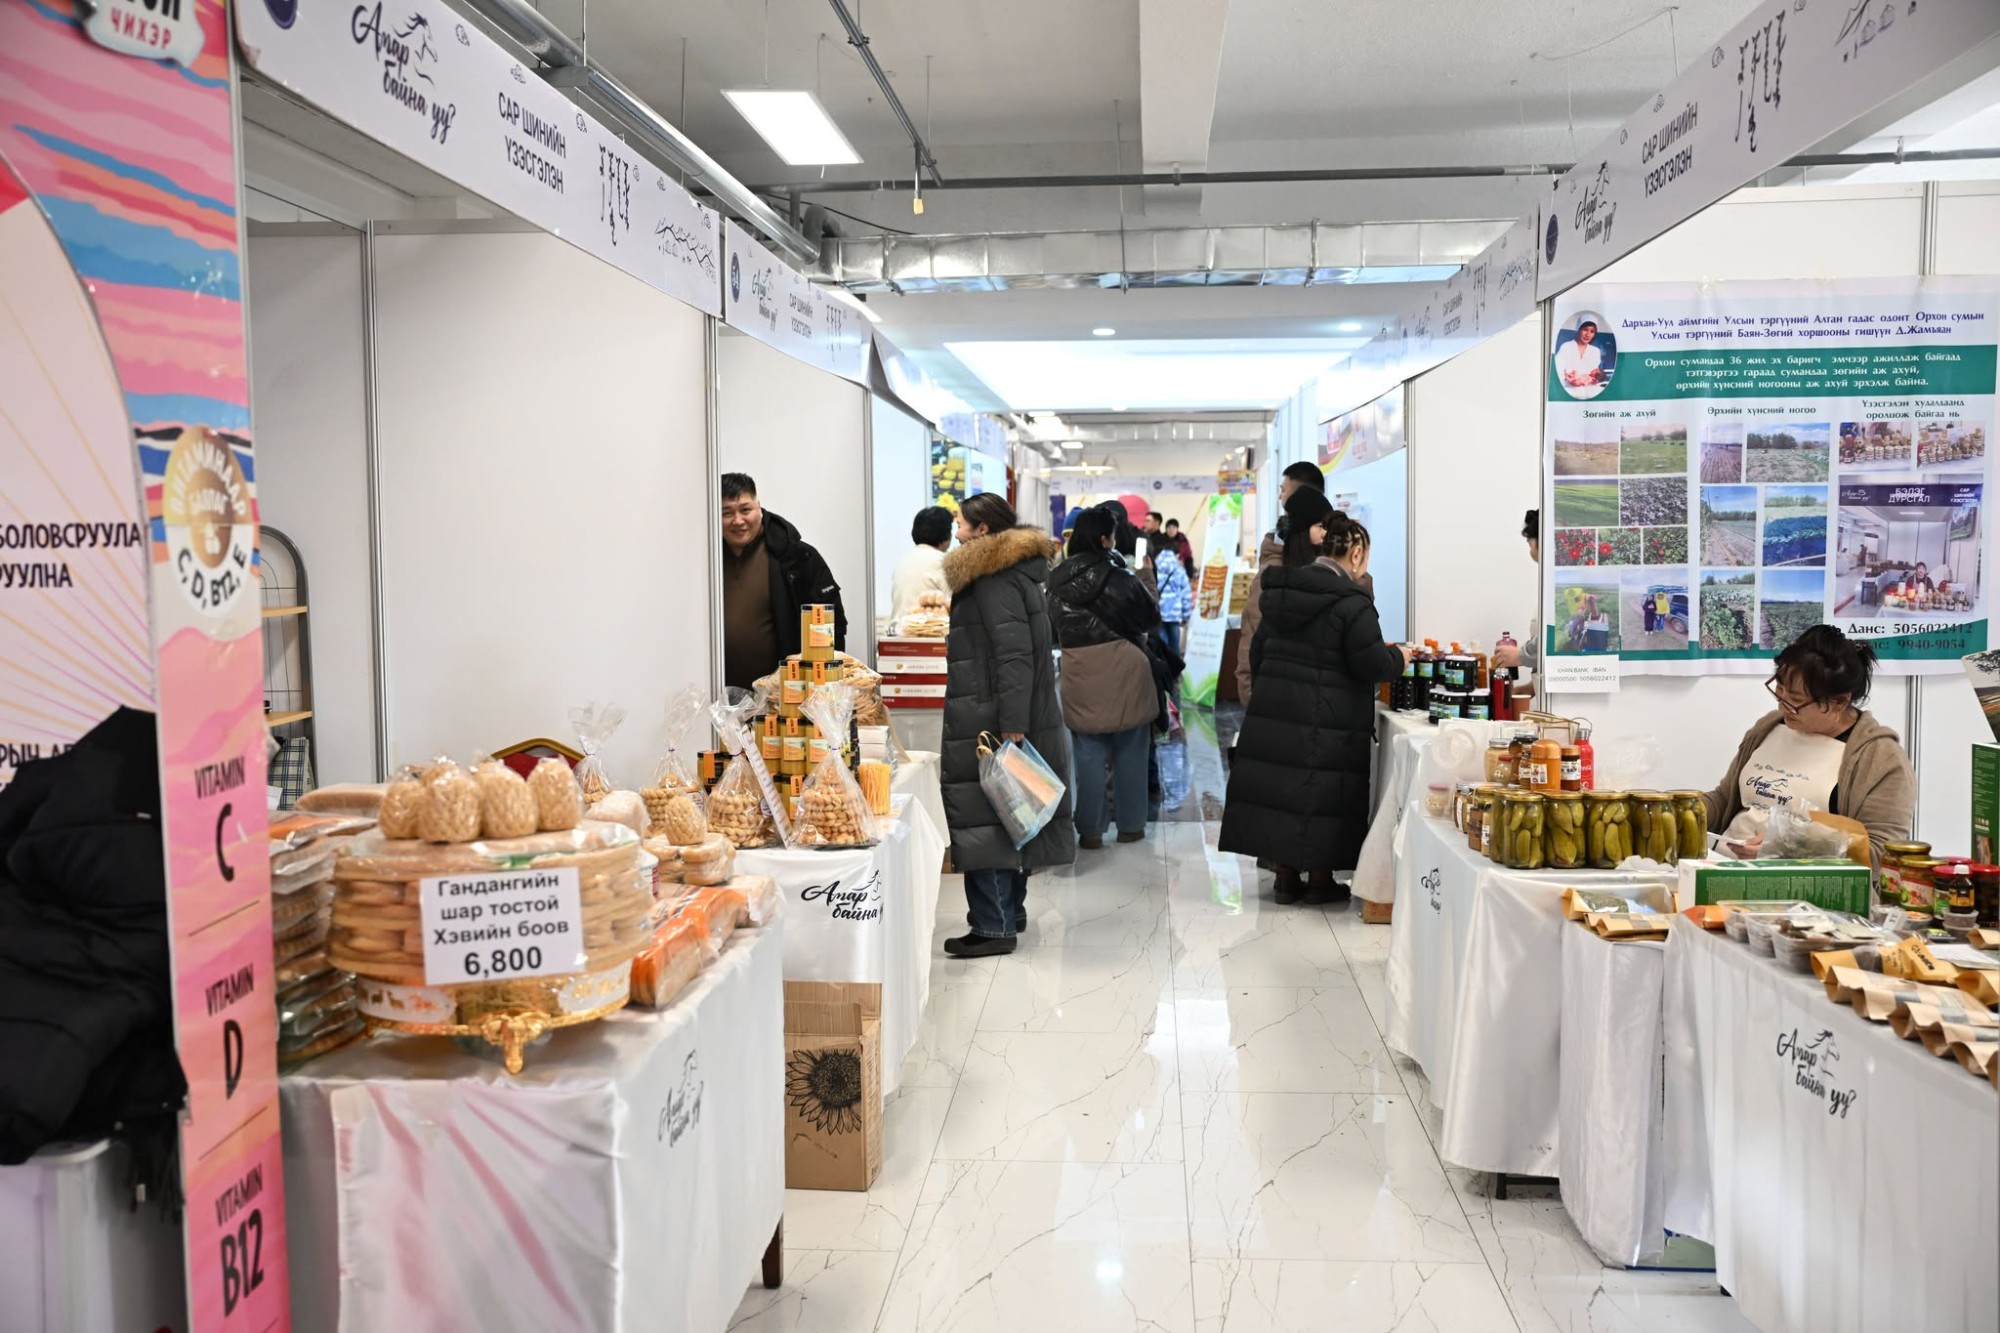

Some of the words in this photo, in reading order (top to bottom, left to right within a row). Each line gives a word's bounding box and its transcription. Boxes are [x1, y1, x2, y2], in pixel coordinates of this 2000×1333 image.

[110, 7, 172, 49] ЧИХЭР
[382, 59, 428, 116] байна
[430, 102, 457, 145] уу?
[498, 91, 520, 126] САР
[521, 106, 567, 159] ШИНИЙН
[1641, 132, 1658, 165] САР
[1658, 101, 1698, 153] ШИНИЙН
[504, 134, 564, 195] ҮЗЭСГЭЛЭН
[1644, 143, 1693, 199] ҮЗЭСГЭЛЭН
[1622, 317, 1674, 330] Дархан-Уул
[1678, 316, 1719, 327] аймгийн
[1724, 315, 1755, 326] Улсын
[1759, 314, 1809, 327] тэргүүний
[1813, 314, 1843, 324] Алтан
[1847, 314, 1876, 324] гадас
[1880, 314, 1910, 323] одонт
[1915, 311, 1947, 324] Орхон
[1951, 312, 1985, 324] сумын
[1651, 330, 1680, 341] Улсын
[1685, 328, 1733, 342] тэргүүний
[1737, 327, 1794, 339] Баян-Зөгий
[1797, 328, 1851, 340] хоршооны
[1854, 327, 1891, 339] гишүүн
[1644, 358, 1676, 370] Орхон
[1680, 357, 1725, 368] сумандаа
[1729, 356, 1742, 366] 36
[1747, 356, 1767, 365] жил
[1770, 356, 1782, 365] эх
[1786, 354, 1821, 366] баригч
[1831, 355, 1869, 366] эмчээр
[1872, 353, 1920, 363] ажиллаж
[1924, 351, 1961, 362] байгаад
[1743, 369, 1776, 379] гараад
[1780, 368, 1828, 378] сумандаа
[1832, 366, 1868, 377] зөгийн
[1872, 367, 1888, 376] аж
[1892, 364, 1920, 376] ахуй,
[1675, 380, 1710, 391] өрхийн
[1713, 379, 1754, 391] хүнсний
[1758, 379, 1801, 389] ногооны
[1805, 379, 1821, 388] аж
[1824, 377, 1848, 389] ахуй
[1853, 378, 1890, 390] эрхэлж
[1894, 376, 1929, 387] байна.
[1582, 408, 1616, 419] Зөгийн
[1619, 410, 1632, 418] аж
[1635, 408, 1657, 420] ахуй
[1707, 405, 1743, 416] Өрхийн
[1747, 405, 1785, 416] хүнсний
[1788, 405, 1817, 414] ногоо
[1862, 399, 1910, 408] Үзэсгэлэн
[1914, 399, 1965, 409] худалдаанд
[1866, 411, 1910, 421] оролцож
[1914, 409, 1945, 419] байгаа
[1948, 410, 1960, 418] нь
[0, 522, 142, 549] ОЛОВСРУУЛА
[0, 562, 74, 589] УУЛНА
[1848, 622, 1886, 635] Данс:
[1892, 622, 1973, 635] 5056022412
[1897, 638, 1966, 651] 9940-9054
[194, 755, 247, 800] VITAMIN
[215, 802, 235, 883] C
[437, 873, 560, 897] Гандангийн
[440, 904, 484, 922] шар
[488, 895, 560, 916] тостой
[831, 901, 878, 922] байна
[433, 923, 512, 946] Хэвийн
[517, 920, 570, 937] боов
[463, 945, 543, 978] 6,800
[206, 963, 255, 1019] VITAMIN
[222, 1019, 244, 1101] D
[213, 1163, 264, 1228] VITAMIN
[220, 1208, 265, 1319] B12
